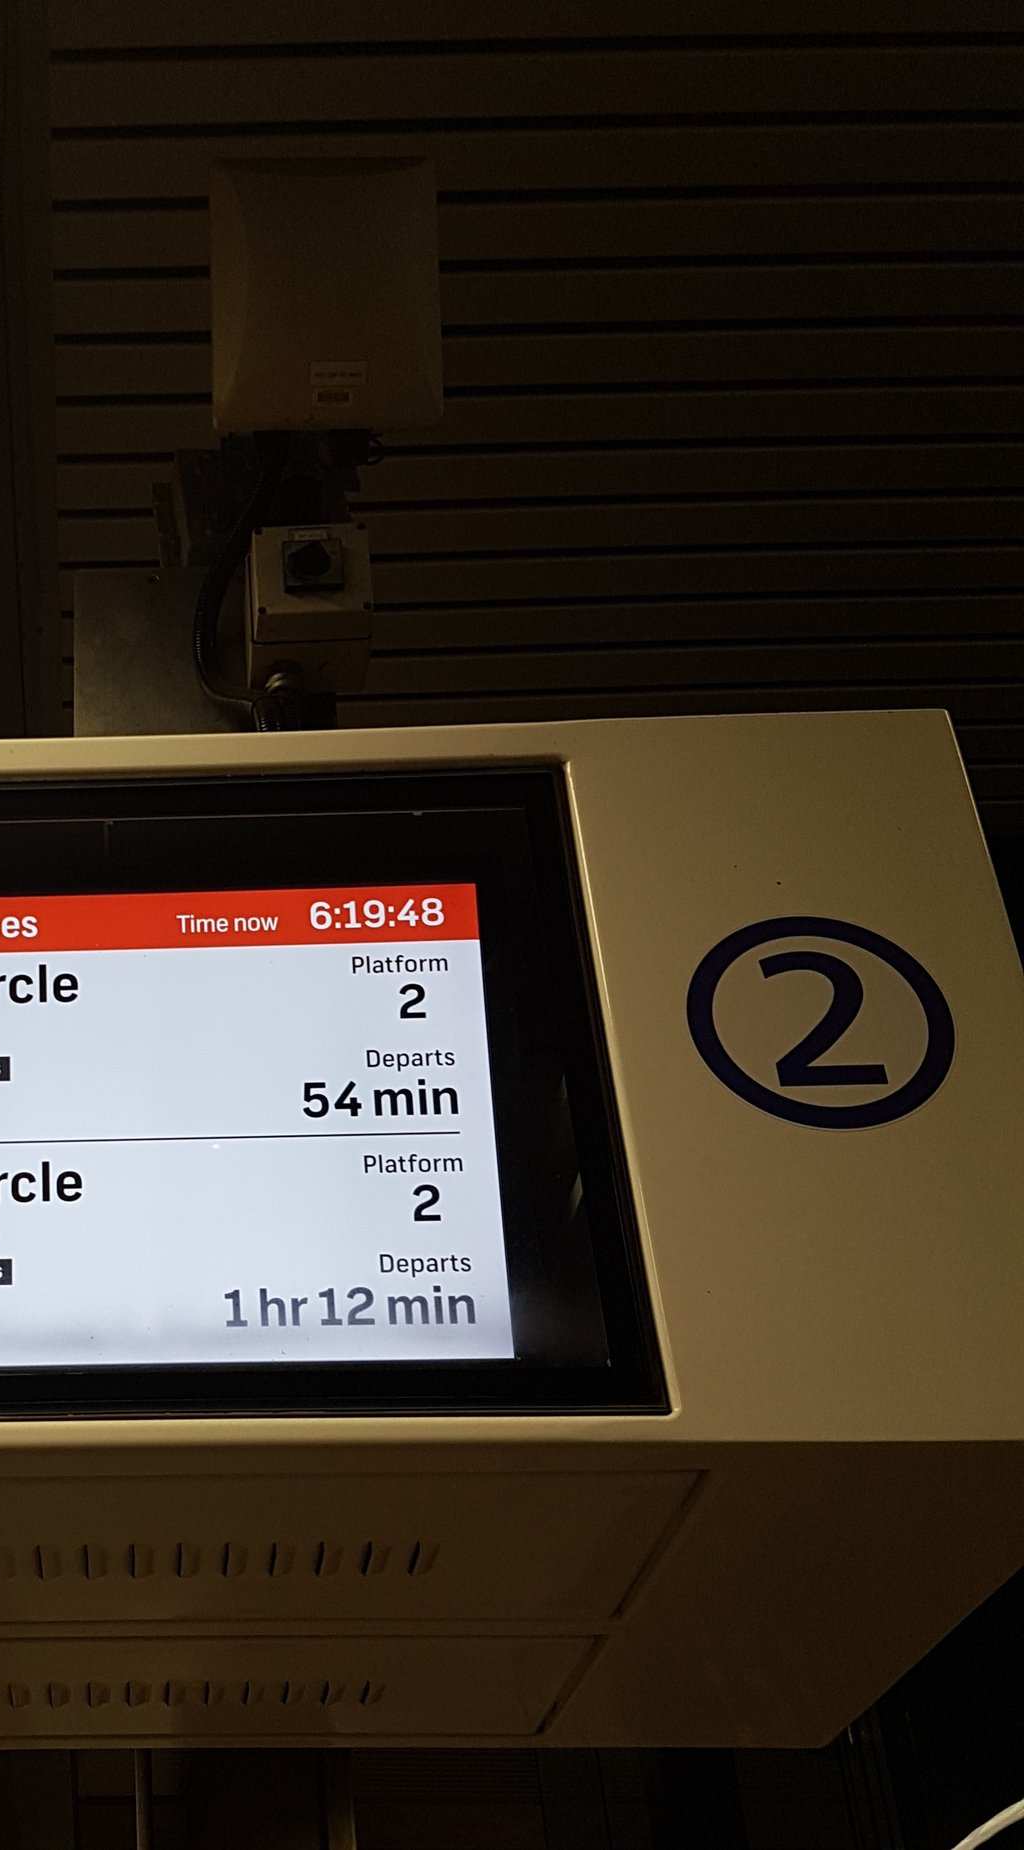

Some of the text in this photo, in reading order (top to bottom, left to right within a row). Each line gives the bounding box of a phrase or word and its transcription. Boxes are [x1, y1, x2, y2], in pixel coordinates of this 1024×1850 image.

[176, 897, 445, 934] Time now 6:19:48
[351, 954, 449, 974] Platform
[399, 983, 427, 1019] 2
[758, 950, 889, 1088] 2
[366, 1049, 456, 1072] Departs
[302, 1078, 459, 1119] 54 min
[363, 1153, 463, 1174] Platform
[412, 1184, 442, 1222] 2
[379, 1253, 472, 1278] Departs
[224, 1285, 477, 1328] 1 hr 12 min
